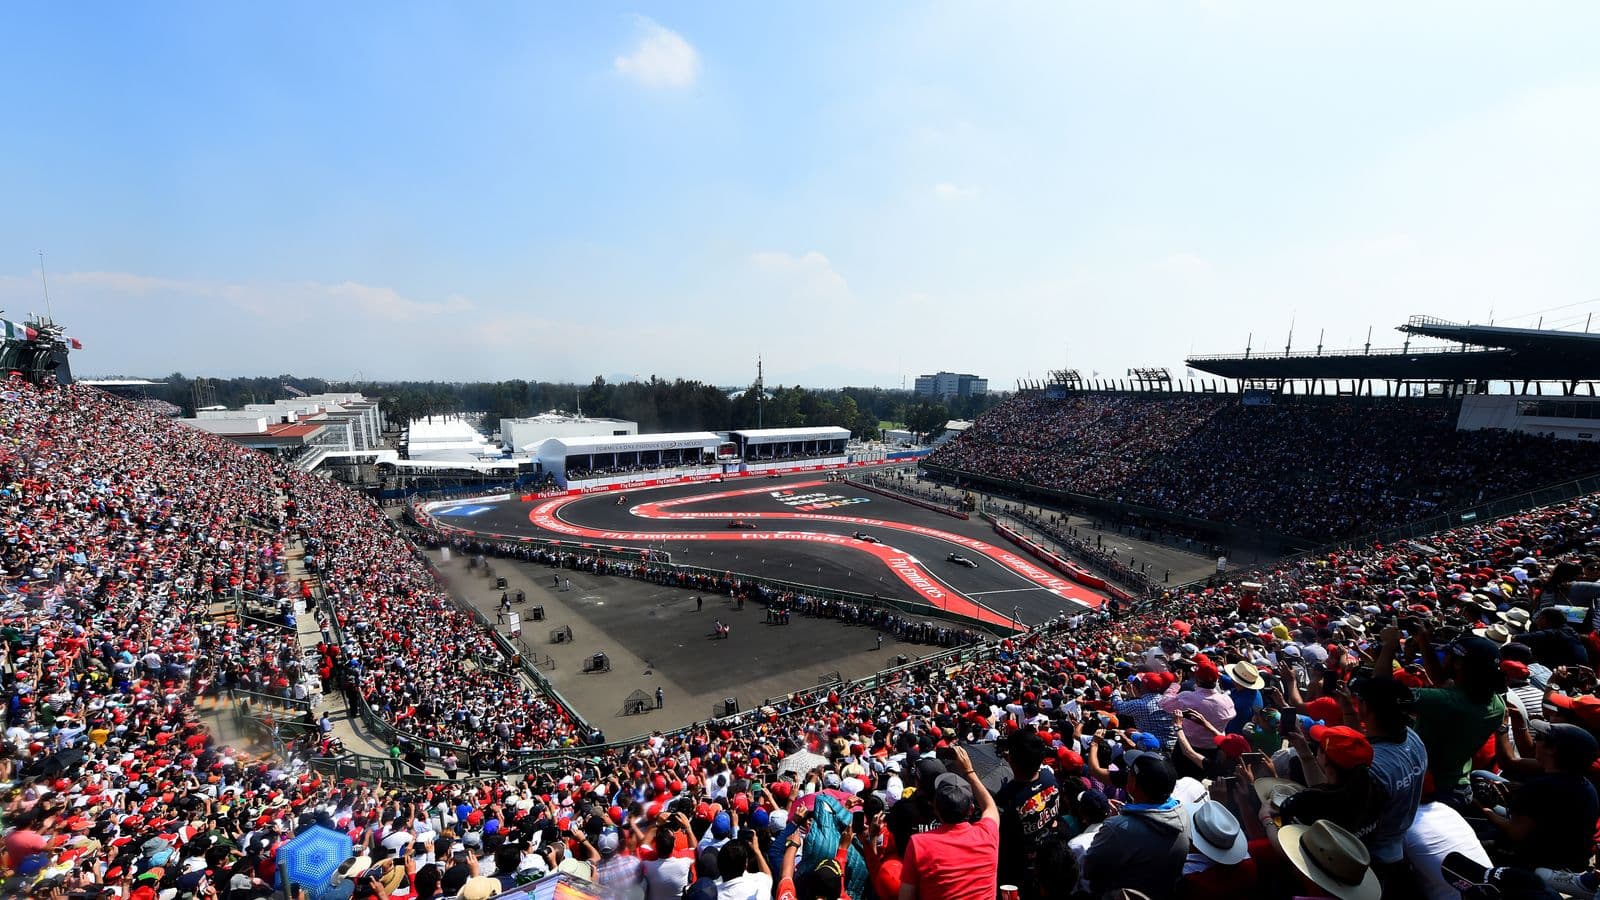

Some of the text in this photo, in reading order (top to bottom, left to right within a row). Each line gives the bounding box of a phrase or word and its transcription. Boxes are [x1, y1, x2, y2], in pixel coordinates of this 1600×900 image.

[547, 489, 568, 497] Emirates
[774, 532, 864, 544] Emirates
[889, 558, 946, 598] Fly Emirates
